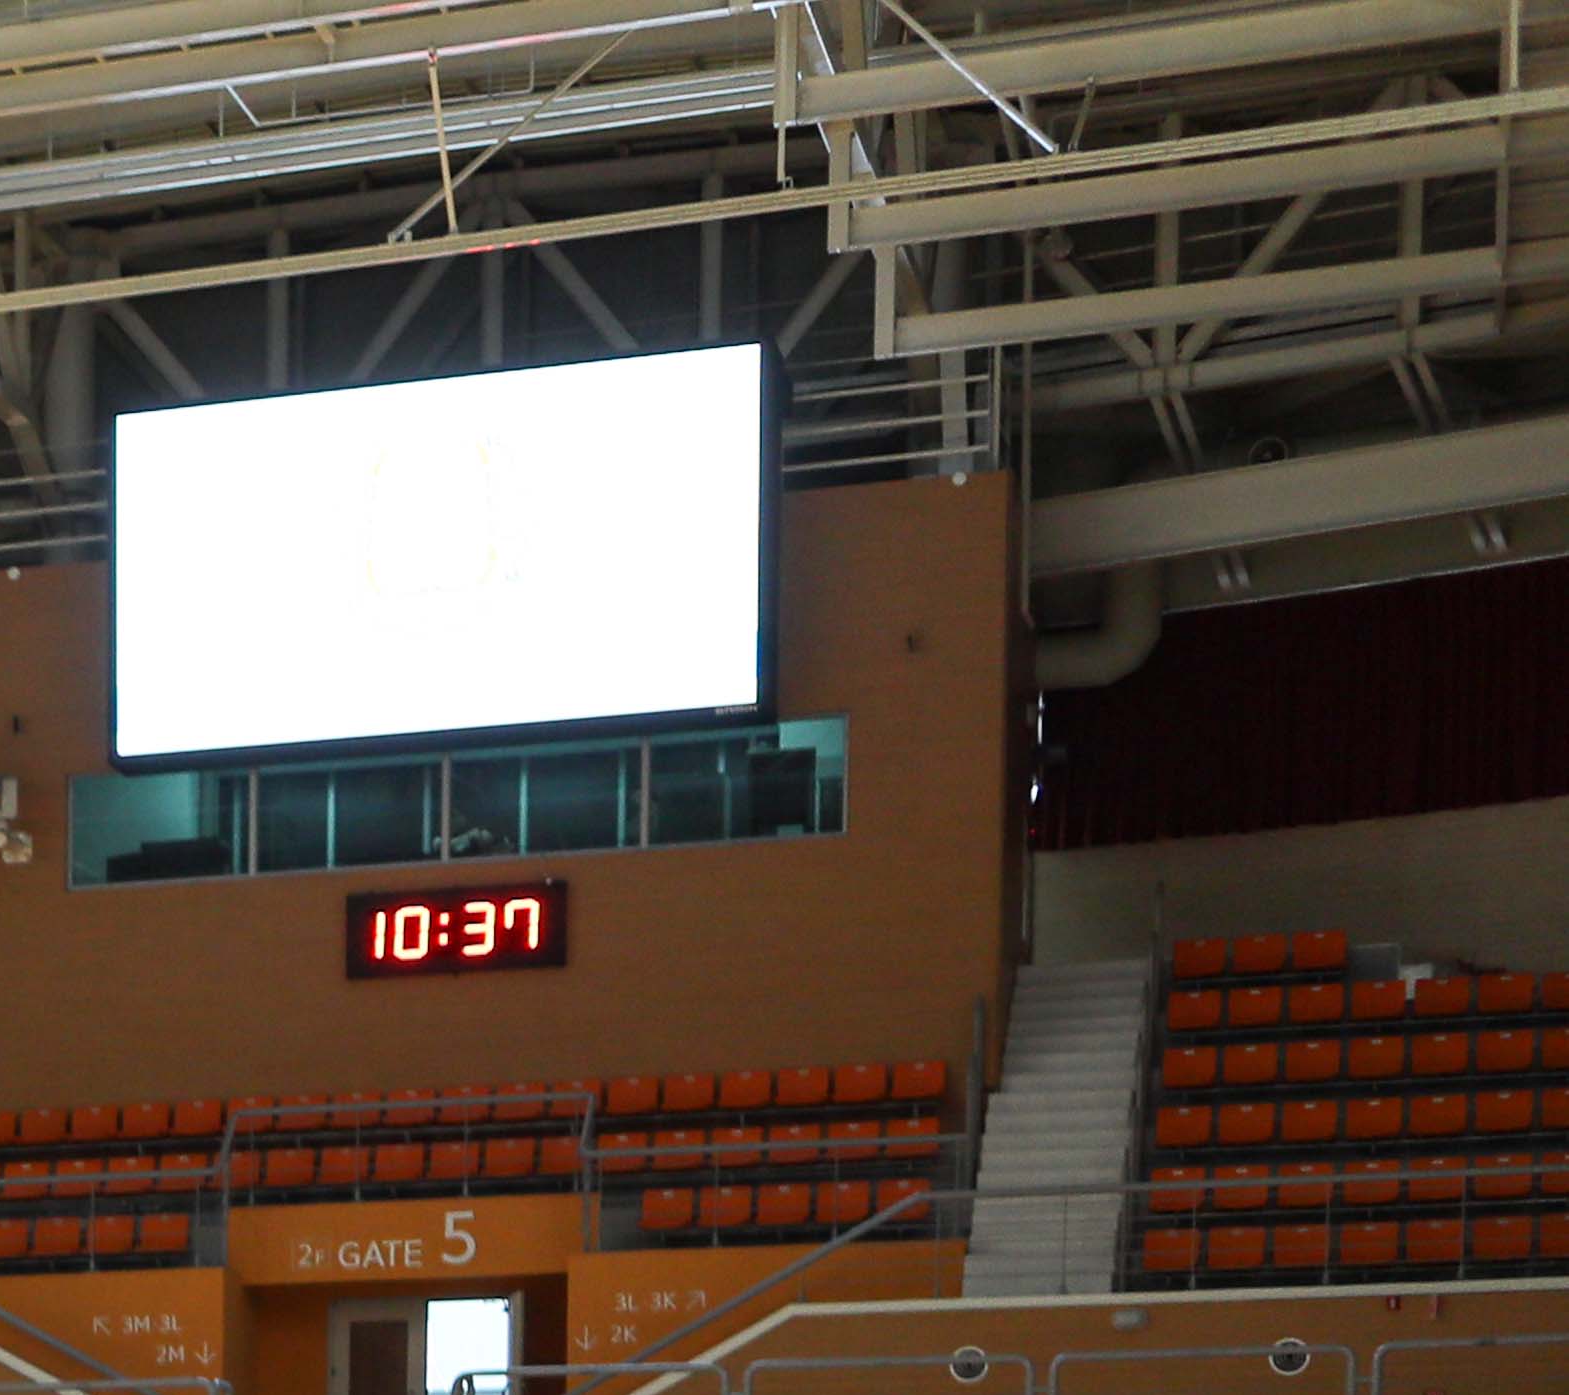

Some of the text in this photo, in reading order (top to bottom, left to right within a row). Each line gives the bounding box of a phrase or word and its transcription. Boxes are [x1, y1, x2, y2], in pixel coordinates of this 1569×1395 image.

[374, 898, 540, 961] 10:37
[337, 1238, 423, 1270] GATE
[441, 1209, 477, 1265] 5
